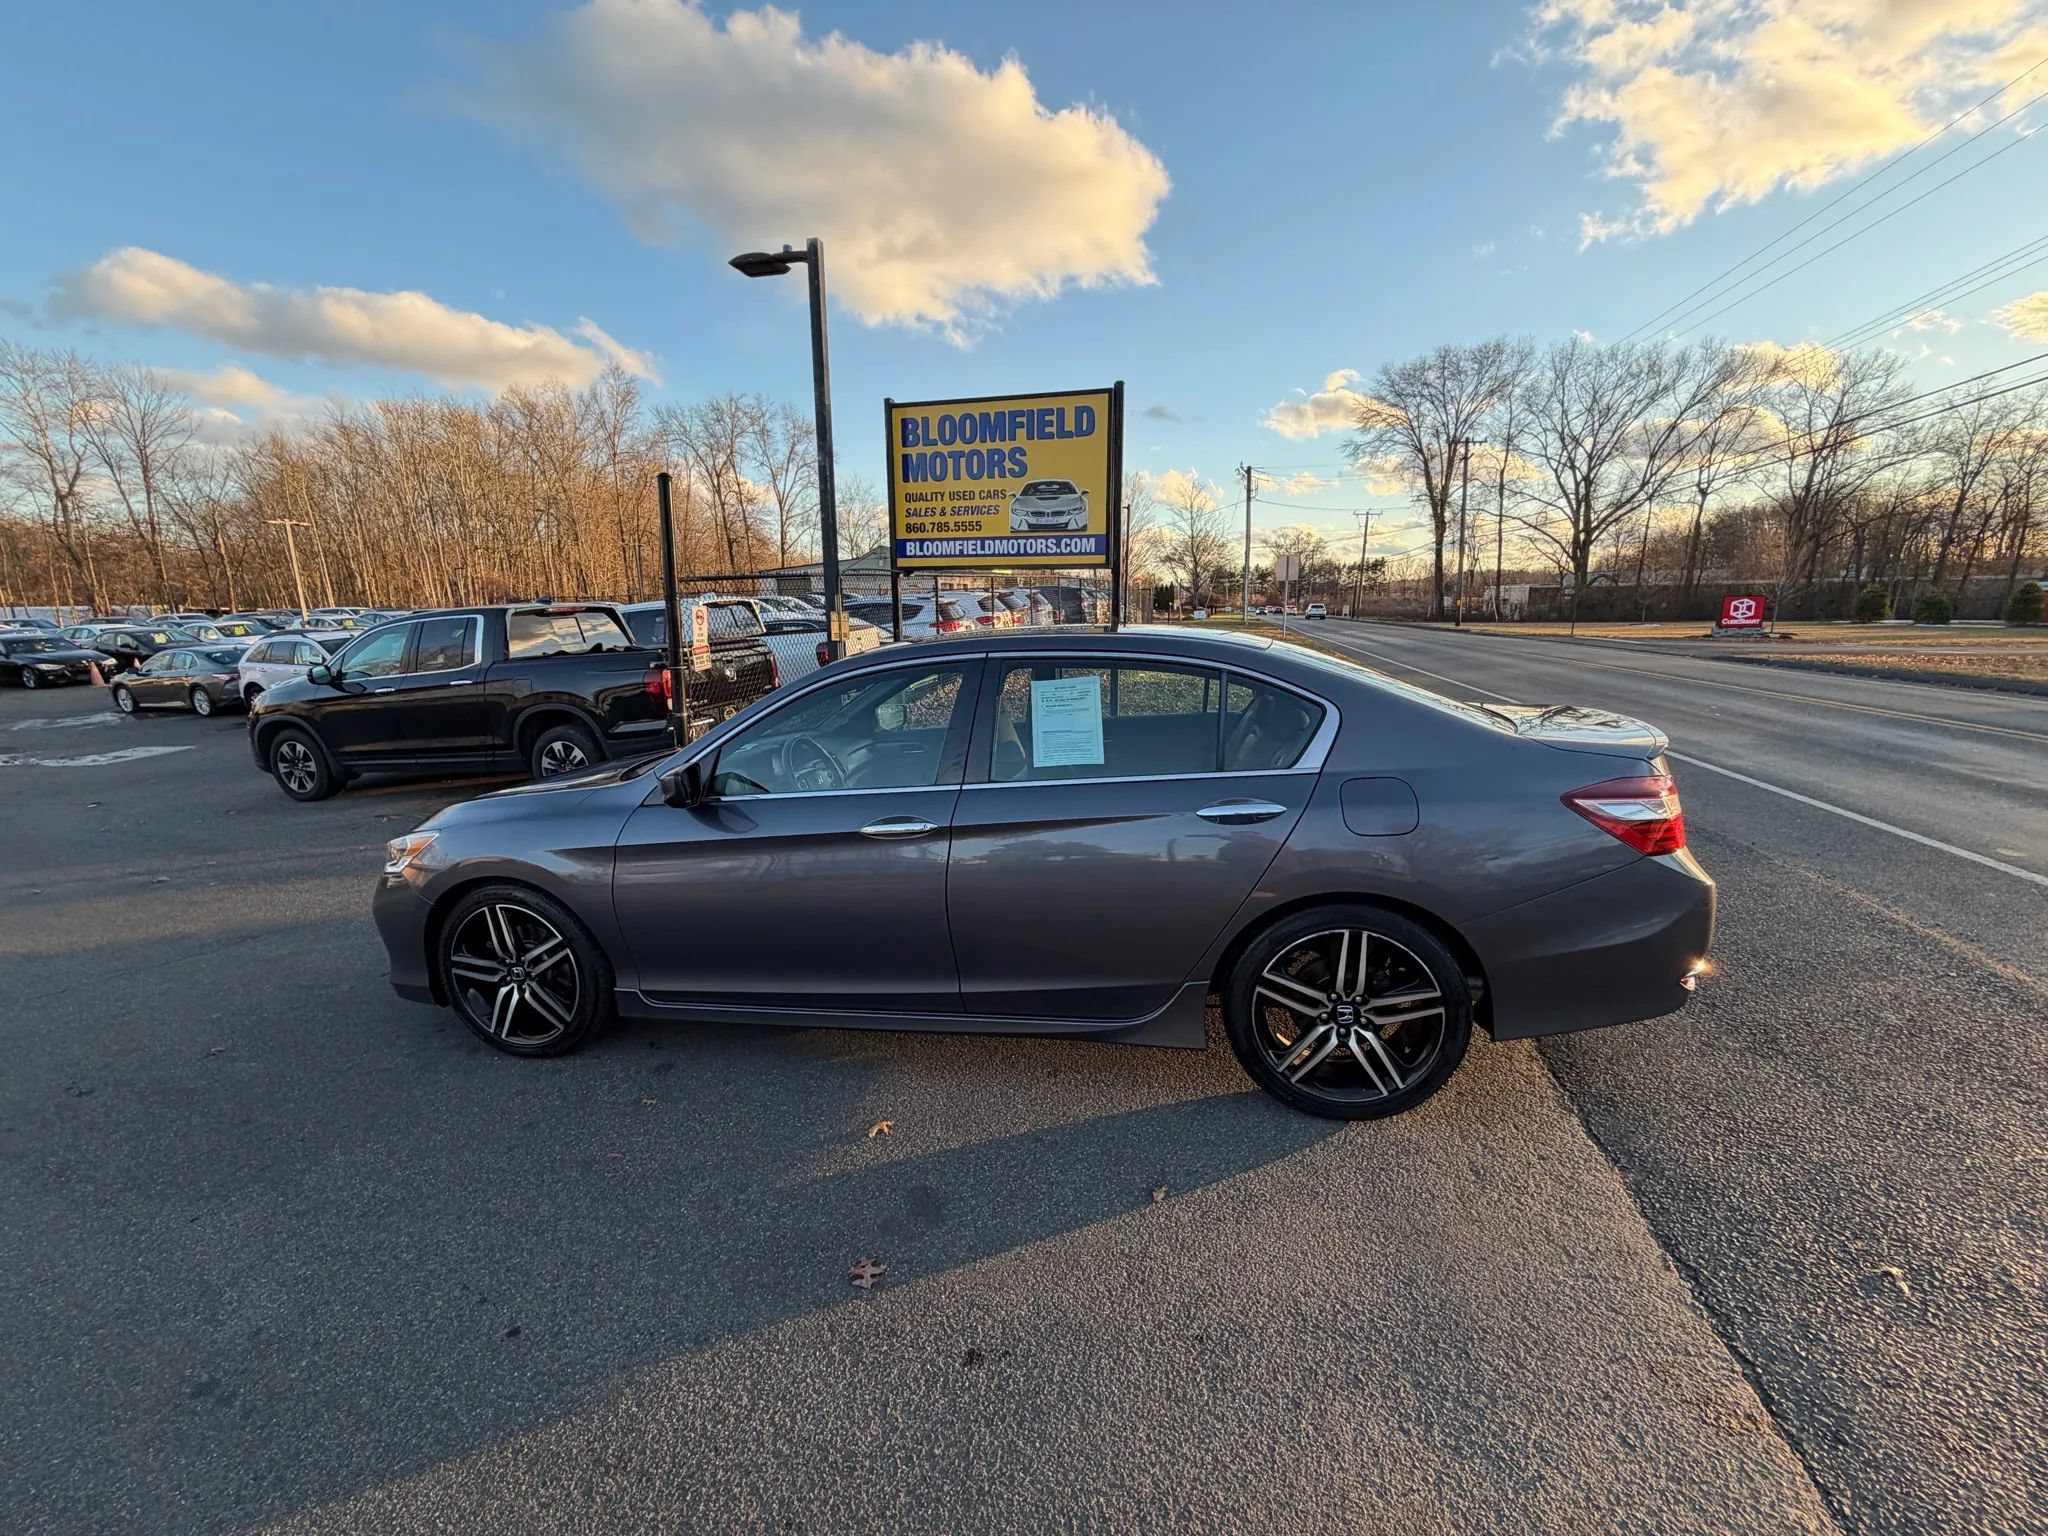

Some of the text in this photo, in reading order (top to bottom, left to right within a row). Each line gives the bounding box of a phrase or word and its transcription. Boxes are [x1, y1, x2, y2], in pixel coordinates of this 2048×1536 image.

[900, 405, 1096, 448] BLOOMFIELD
[901, 447, 1028, 483] MOTORS
[904, 489, 1007, 504] QUALITY USED CARS
[904, 504, 1001, 518] SALES & SERVICES
[905, 521, 982, 534] 860.785.5555
[905, 537, 1096, 556] BLOOMFIELDMOTORS.COM
